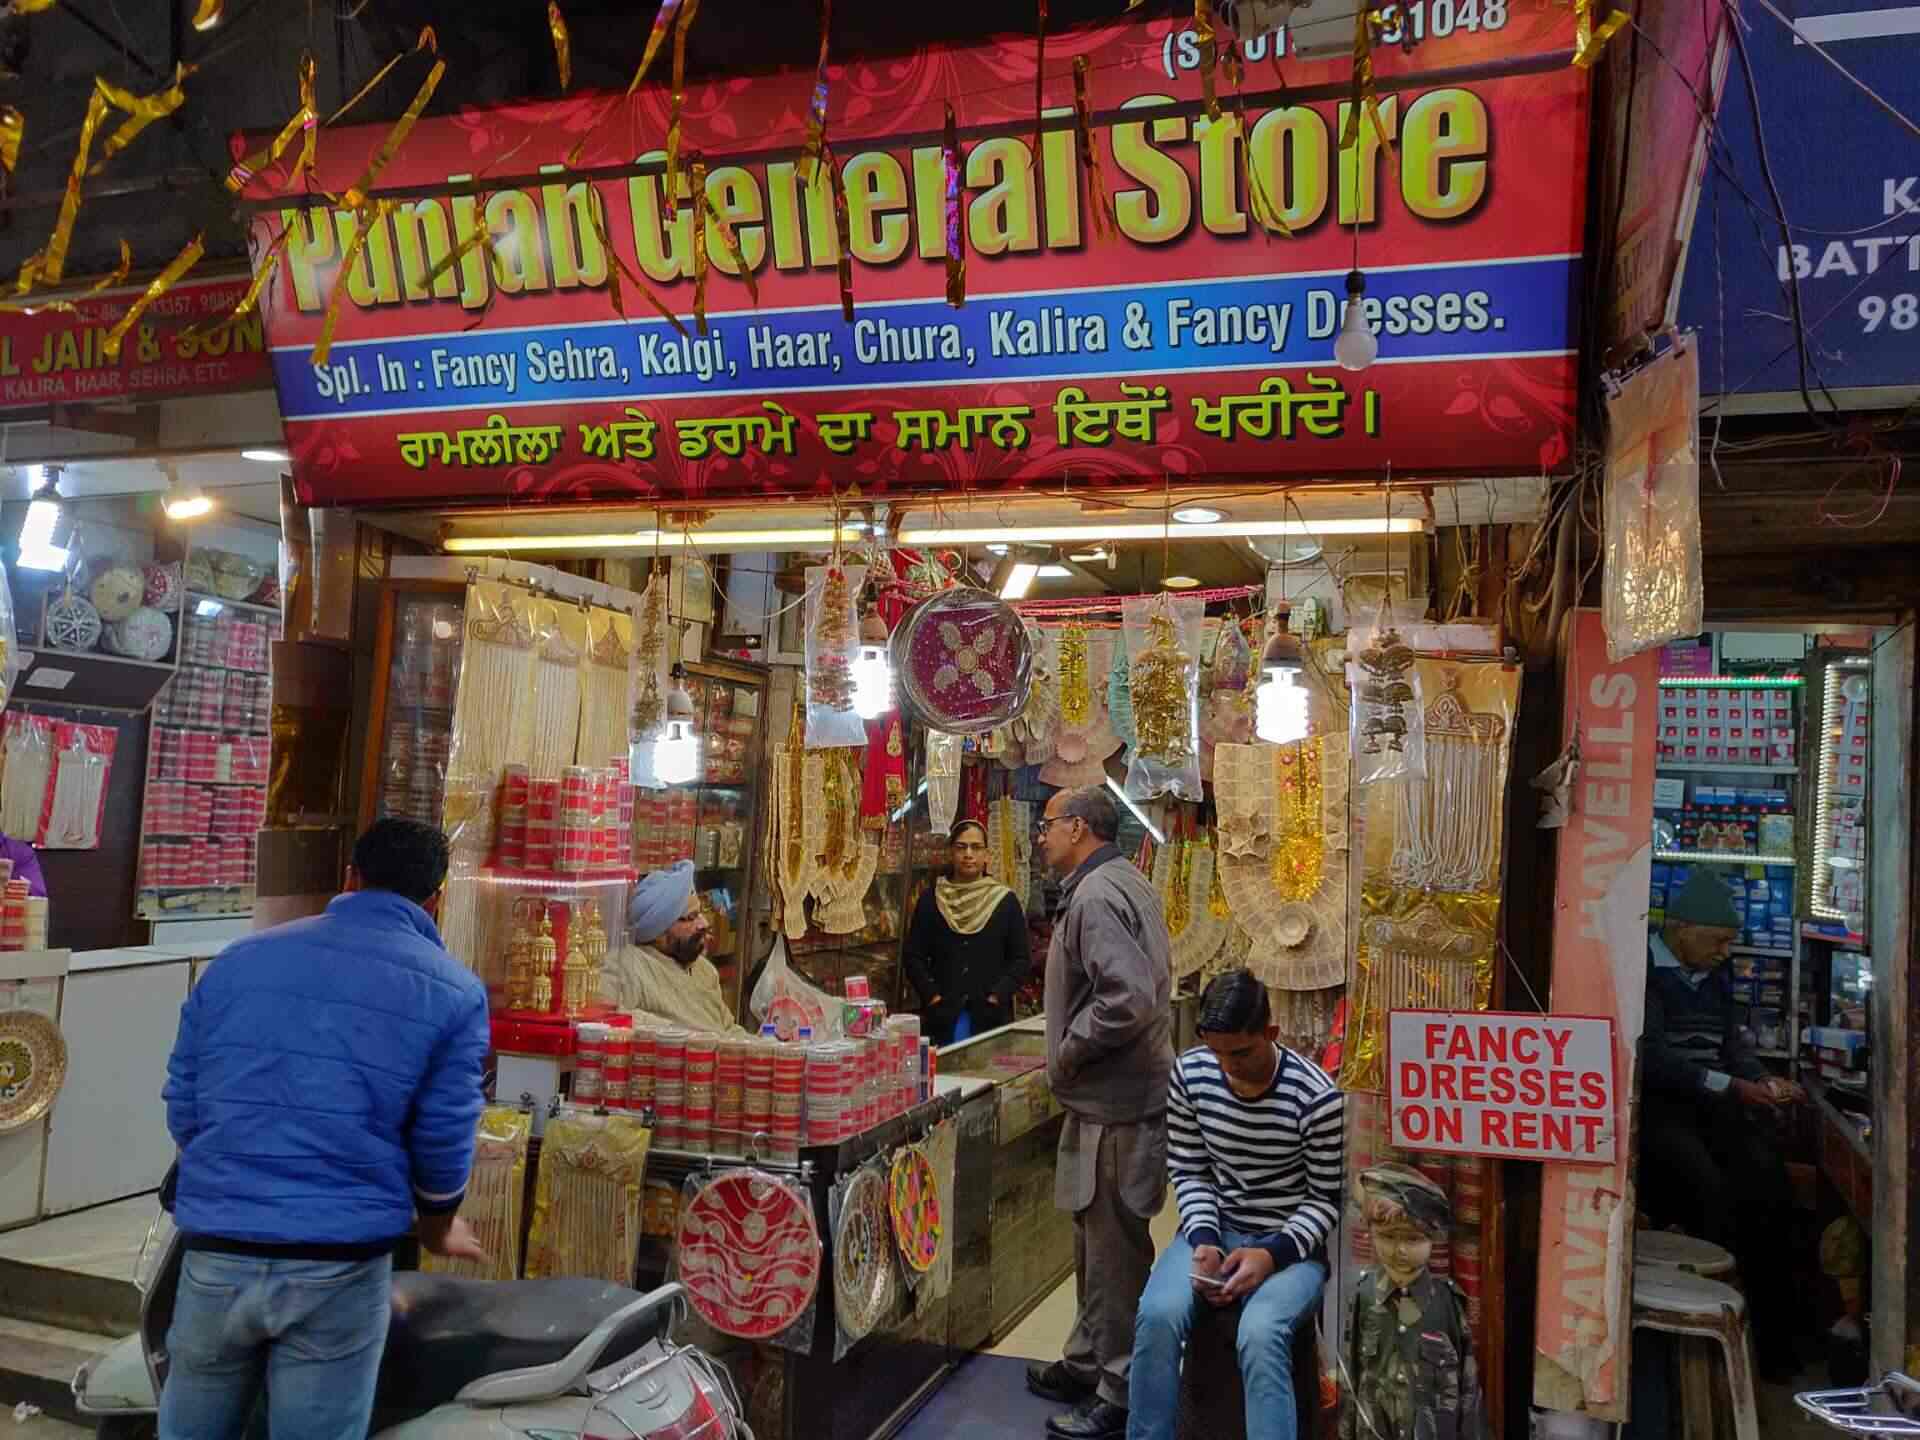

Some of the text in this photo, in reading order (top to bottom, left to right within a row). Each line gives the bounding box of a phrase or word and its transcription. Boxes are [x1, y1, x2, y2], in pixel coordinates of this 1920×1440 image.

[281, 87, 1489, 311] Punjab General Store
[313, 355, 371, 403] Spl.
[378, 352, 408, 392] In
[430, 348, 516, 393] Fancy
[526, 339, 631, 384] Sehra,
[638, 329, 738, 382] Kalgi,
[747, 323, 841, 373] Haar,
[853, 317, 977, 366] Chura,
[989, 306, 1107, 357] Kalira
[1121, 301, 1152, 350] &
[1166, 296, 1292, 353] Fancy
[1306, 289, 1506, 338] Desses.
[397, 414, 562, 468] ਰਾਮਲੀਲਾ
[578, 407, 656, 459] ਅਤੇ
[674, 400, 795, 457] ਡਰਾਮੇ
[815, 412, 873, 452] ਦਾ
[892, 406, 1031, 449] ਸਮਾਨ
[1052, 382, 1167, 445] ਇਥੋਂ
[1191, 372, 1346, 438] ਖਰੀਦੋ
[1425, 1023, 1573, 1066] FANCY
[1400, 1061, 1607, 1110] DRESSES
[1401, 1104, 1604, 1153] ON RENT
